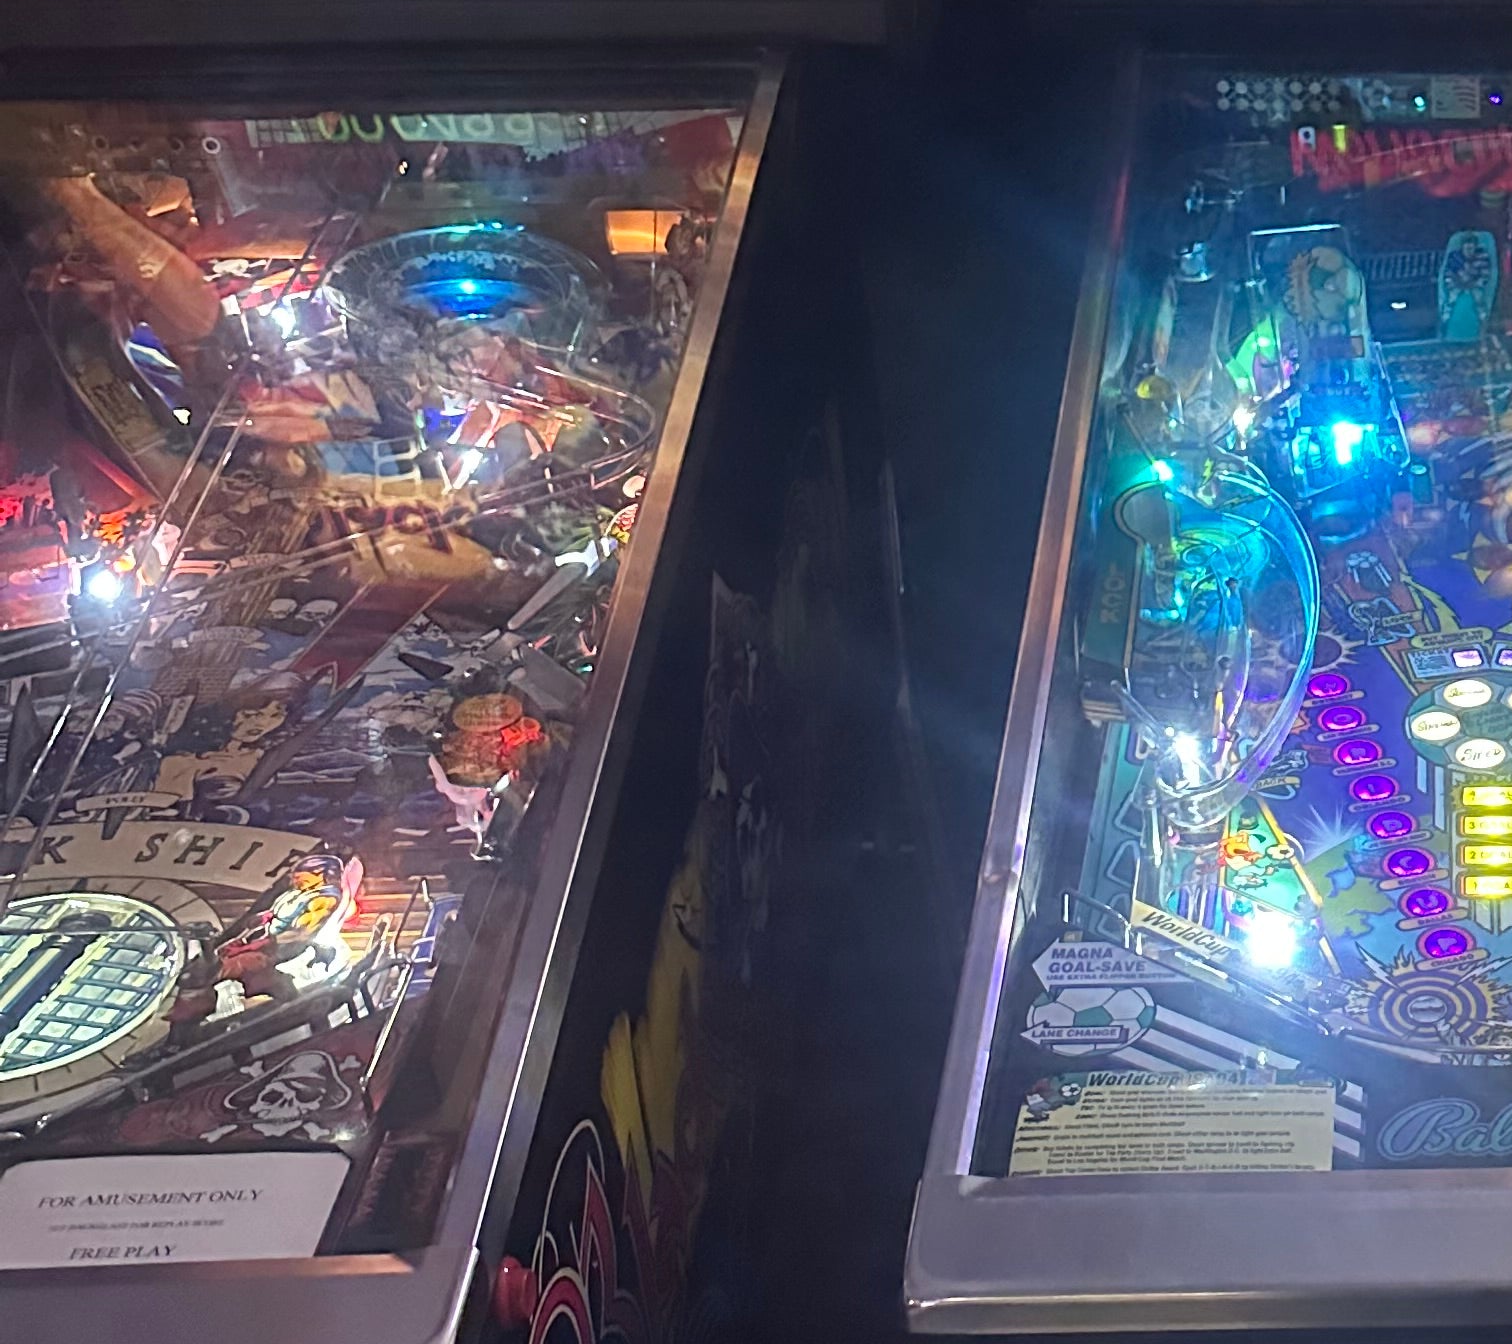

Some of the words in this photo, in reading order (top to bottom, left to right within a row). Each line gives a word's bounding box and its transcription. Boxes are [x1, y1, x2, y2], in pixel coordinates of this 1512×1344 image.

[1468, 821, 1476, 830] 3
[1468, 850, 1477, 860] 2
[1418, 913, 1454, 926] DALLAS
[1051, 947, 1114, 959] MAGNA
[1049, 960, 1146, 973] GOAL-SAVE
[1431, 952, 1475, 968] CHICAGO
[1031, 1028, 1066, 1038] LANE
[1066, 1027, 1118, 1038] CHANGE
[38, 1196, 75, 1209] FOR
[81, 1192, 208, 1206] AMUSEMENT
[208, 1189, 264, 1203] ONLY
[70, 1246, 121, 1260] FREE
[124, 1244, 178, 1258] PLAY
